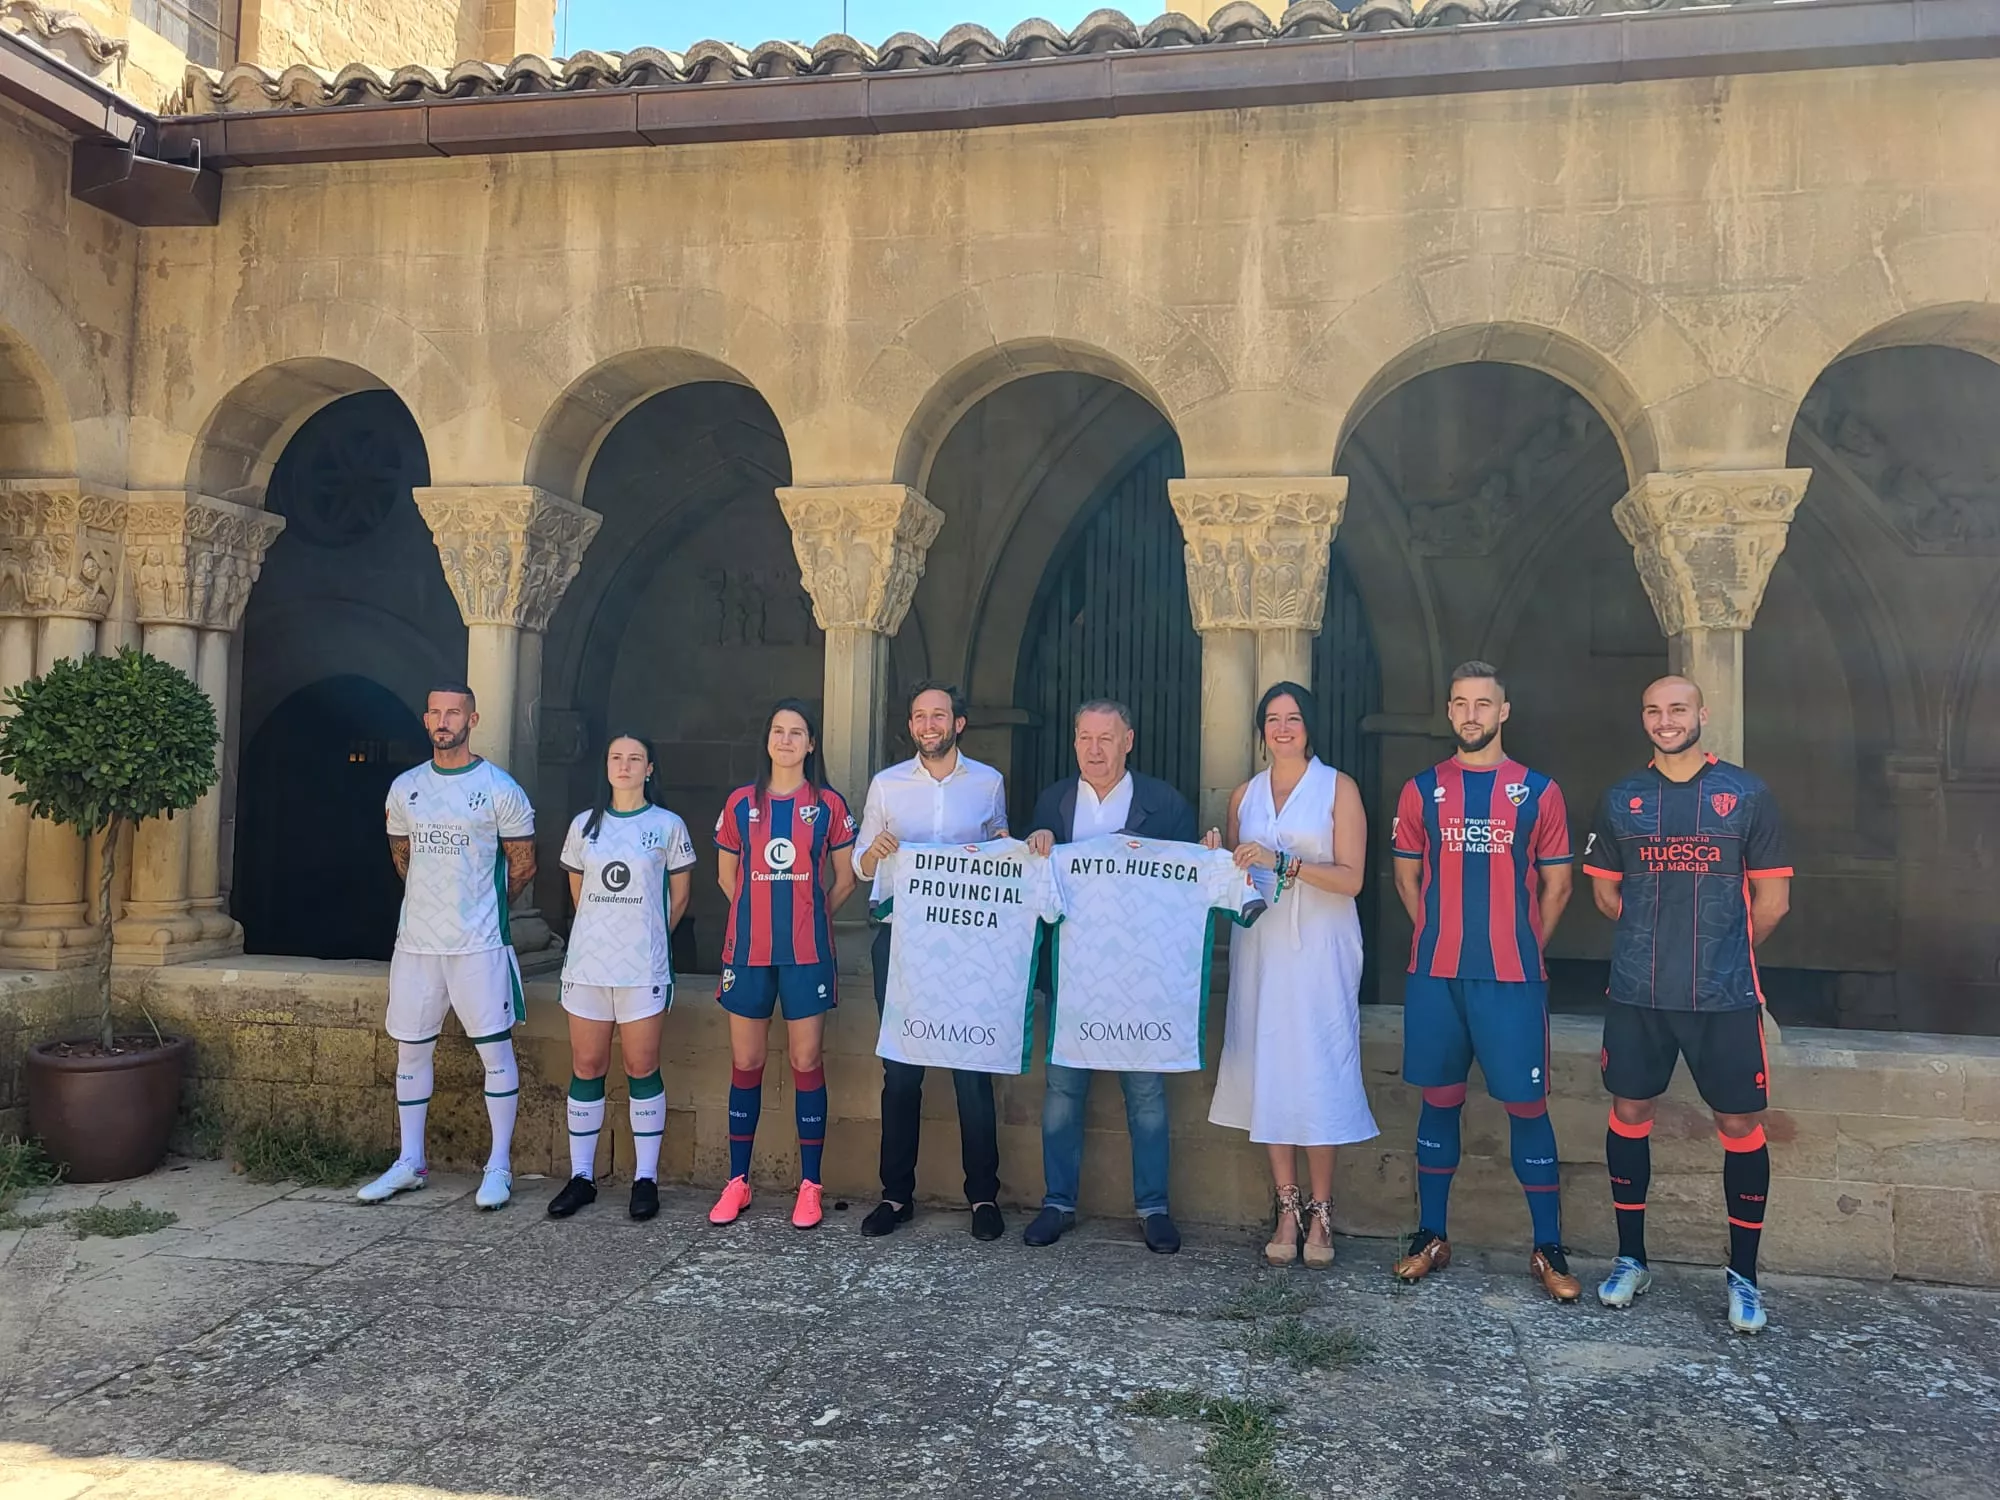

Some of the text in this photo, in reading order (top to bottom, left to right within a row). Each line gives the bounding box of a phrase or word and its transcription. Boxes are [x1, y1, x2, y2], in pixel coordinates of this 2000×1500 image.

[751, 870, 810, 881] Casademont
[915, 853, 1023, 878] DIPUTACIÓN
[1070, 858, 1198, 882] AYTO. HUESCA
[588, 892, 643, 905] Casademont
[908, 878, 1023, 905] PROVINCIAL
[926, 905, 998, 929] HUESCA
[902, 1018, 996, 1046] SOMMOS
[1079, 1021, 1172, 1042] SOMMOS
